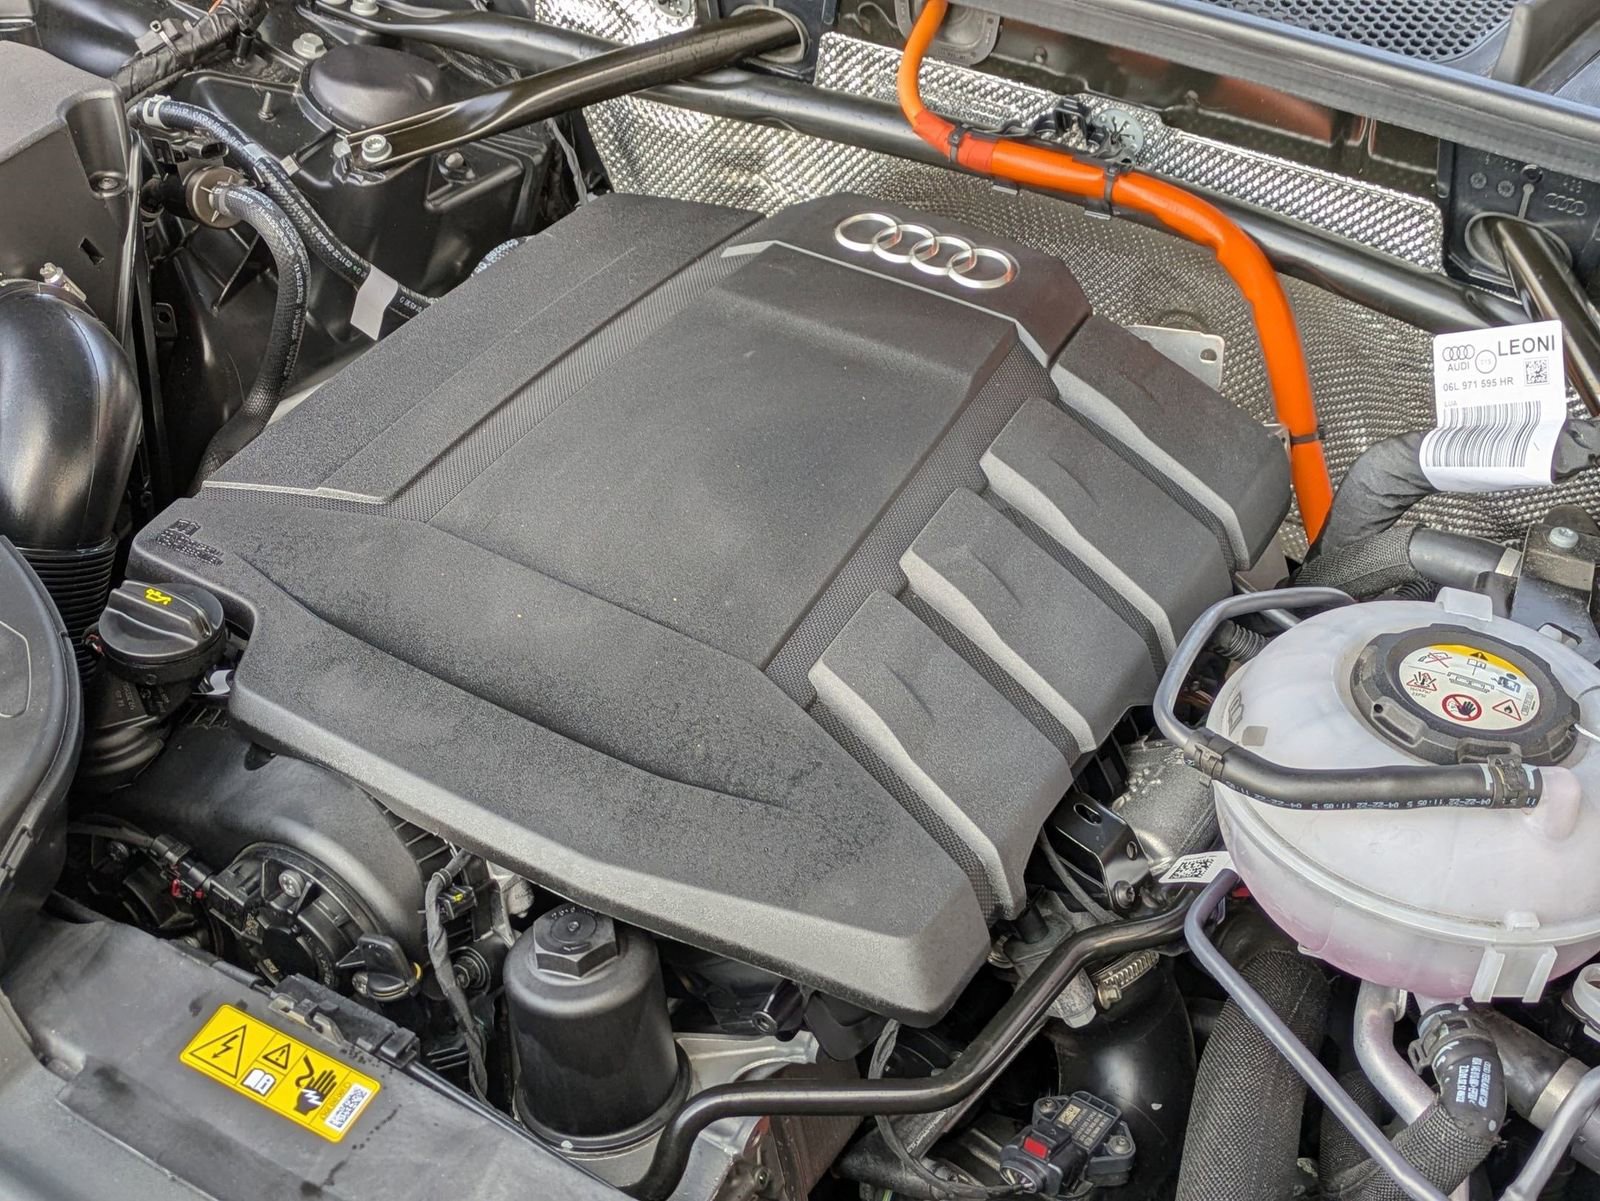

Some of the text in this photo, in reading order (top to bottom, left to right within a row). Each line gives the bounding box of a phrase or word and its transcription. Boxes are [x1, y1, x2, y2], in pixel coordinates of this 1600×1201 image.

[1497, 334, 1556, 357] LEONI
[1447, 361, 1470, 372] AUDI
[1442, 383, 1460, 392] 06L
[1462, 380, 1478, 390] 971
[1499, 376, 1514, 387] HR
